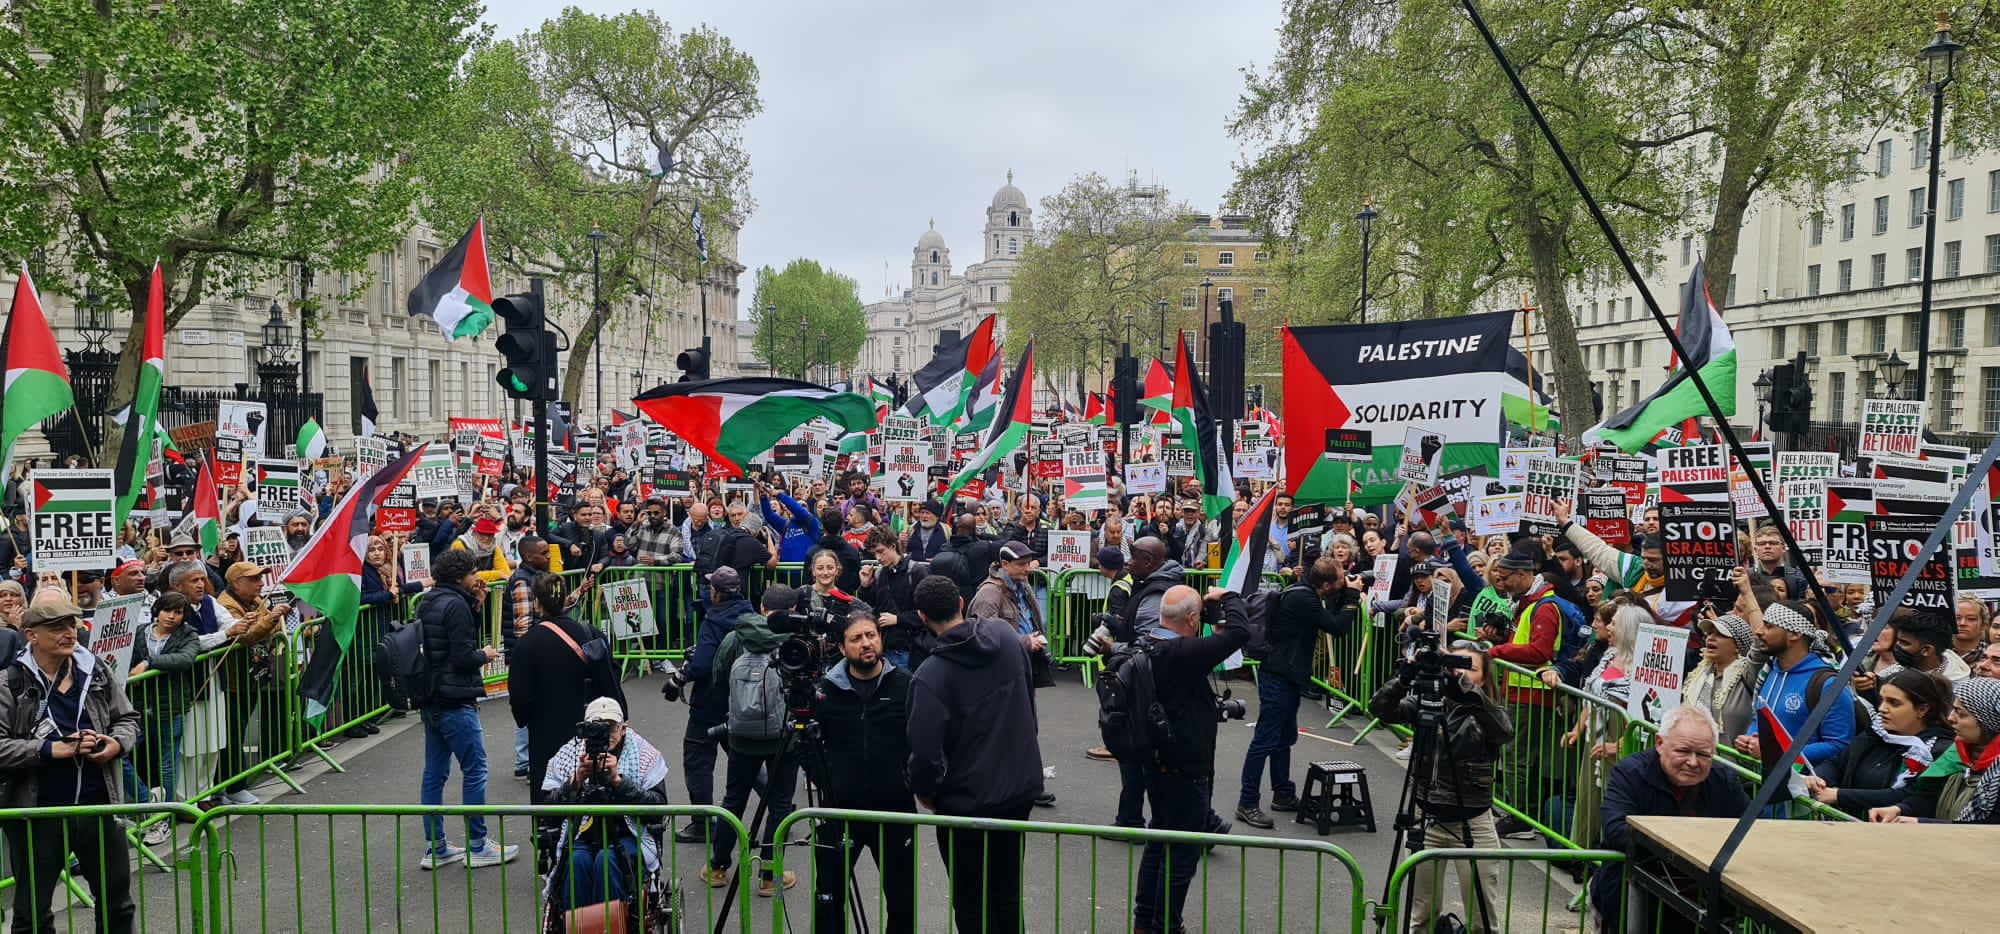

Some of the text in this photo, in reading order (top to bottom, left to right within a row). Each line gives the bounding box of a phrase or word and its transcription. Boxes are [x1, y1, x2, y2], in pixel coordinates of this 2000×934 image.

[1358, 334, 1482, 363] PALESTINE
[1354, 398, 1487, 424] SOLIDARITY
[1867, 402, 1920, 414] FREE PALESTINE
[1866, 414, 1919, 425] EXIST!
[1865, 425, 1919, 434] RESIST!
[523, 438, 537, 450] FR
[1863, 434, 1917, 453] RETURN!
[894, 454, 920, 464] ISRAELI
[1069, 452, 1099, 466] FREE
[1161, 449, 1193, 461] FREE
[1668, 447, 1720, 468] FREE
[1781, 454, 1834, 465] FREE PALESTINE
[823, 461, 835, 474] EE
[1528, 459, 1577, 475] FREE PALESTINE
[1616, 461, 1643, 470] FREEDOM
[1780, 466, 1833, 477] EXIST!
[415, 467, 454, 481] FREE
[1527, 472, 1576, 487] EXIST!
[1614, 472, 1645, 482] PALESTINE
[1662, 468, 1727, 482] PALESTINE
[258, 486, 299, 502] FREE
[392, 486, 413, 496] EDOM
[558, 487, 574, 496] AZA
[258, 501, 298, 510] PALESTINE
[382, 498, 414, 508] ALESTINE
[1589, 496, 1623, 505] FREEDOM
[1789, 496, 1821, 509] EXI
[1588, 509, 1625, 519] PALESTINE
[35, 512, 113, 538] FREE
[1665, 521, 1733, 541] STOP
[1062, 536, 1075, 545] END
[1826, 523, 1865, 549] FR
[35, 537, 113, 551] PALESTINE
[248, 542, 287, 556] EXIST!
[1056, 545, 1081, 554] ISRAELI
[1666, 541, 1735, 556] ISRAEL'S
[1050, 553, 1087, 563] APARTHEID
[1667, 557, 1735, 567] WAR CRIMES
[1827, 549, 1870, 563] PALES
[1670, 567, 1733, 581] IN GZA
[1912, 580, 1947, 591] RIMES
[1901, 593, 1950, 609] GAZA
[110, 607, 127, 623] END
[100, 620, 129, 640] ISRAELI
[92, 632, 133, 656] APARTHEID
[1651, 637, 1668, 654] END
[1642, 651, 1673, 672] ISRAELI
[1634, 665, 1678, 690] APARTHEID
